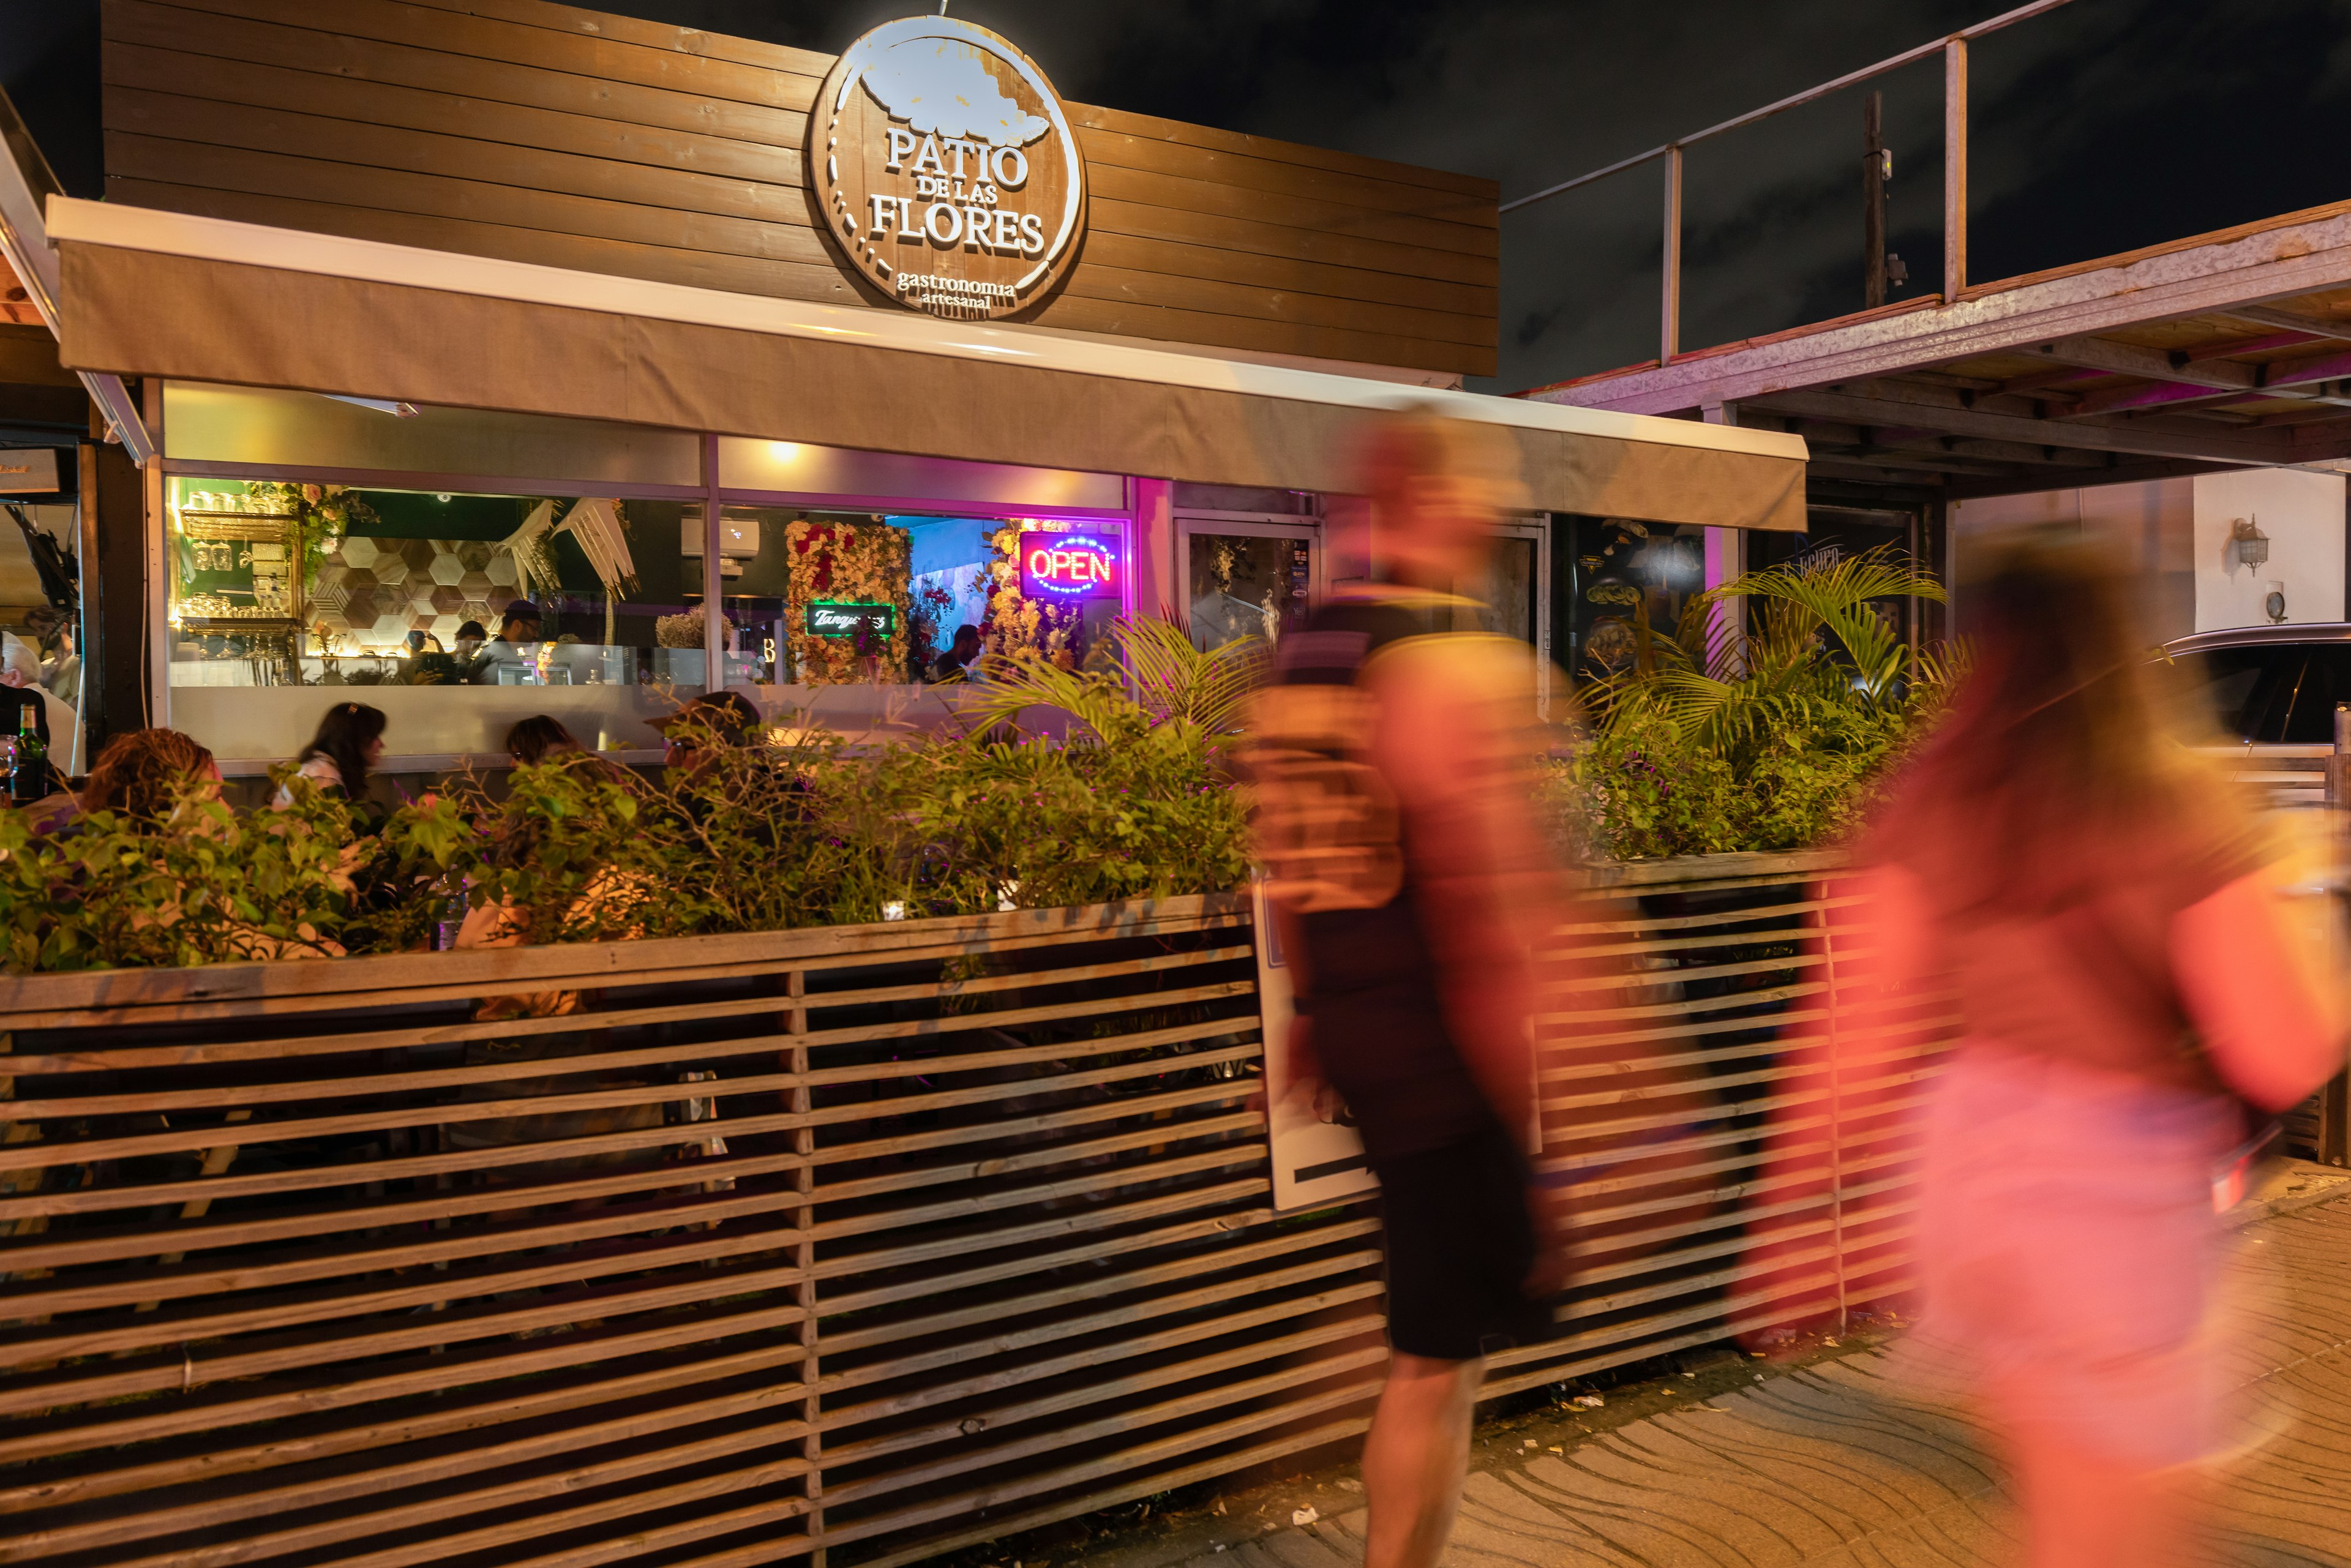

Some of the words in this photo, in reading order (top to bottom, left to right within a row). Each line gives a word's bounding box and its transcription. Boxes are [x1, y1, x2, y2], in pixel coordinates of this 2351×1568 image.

[887, 127, 1028, 186] PATIO
[917, 175, 950, 198] DE
[954, 181, 998, 204] LAS
[869, 193, 1045, 253] FLORES
[921, 293, 991, 310] artesanal
[1030, 550, 1110, 581] OPEN
